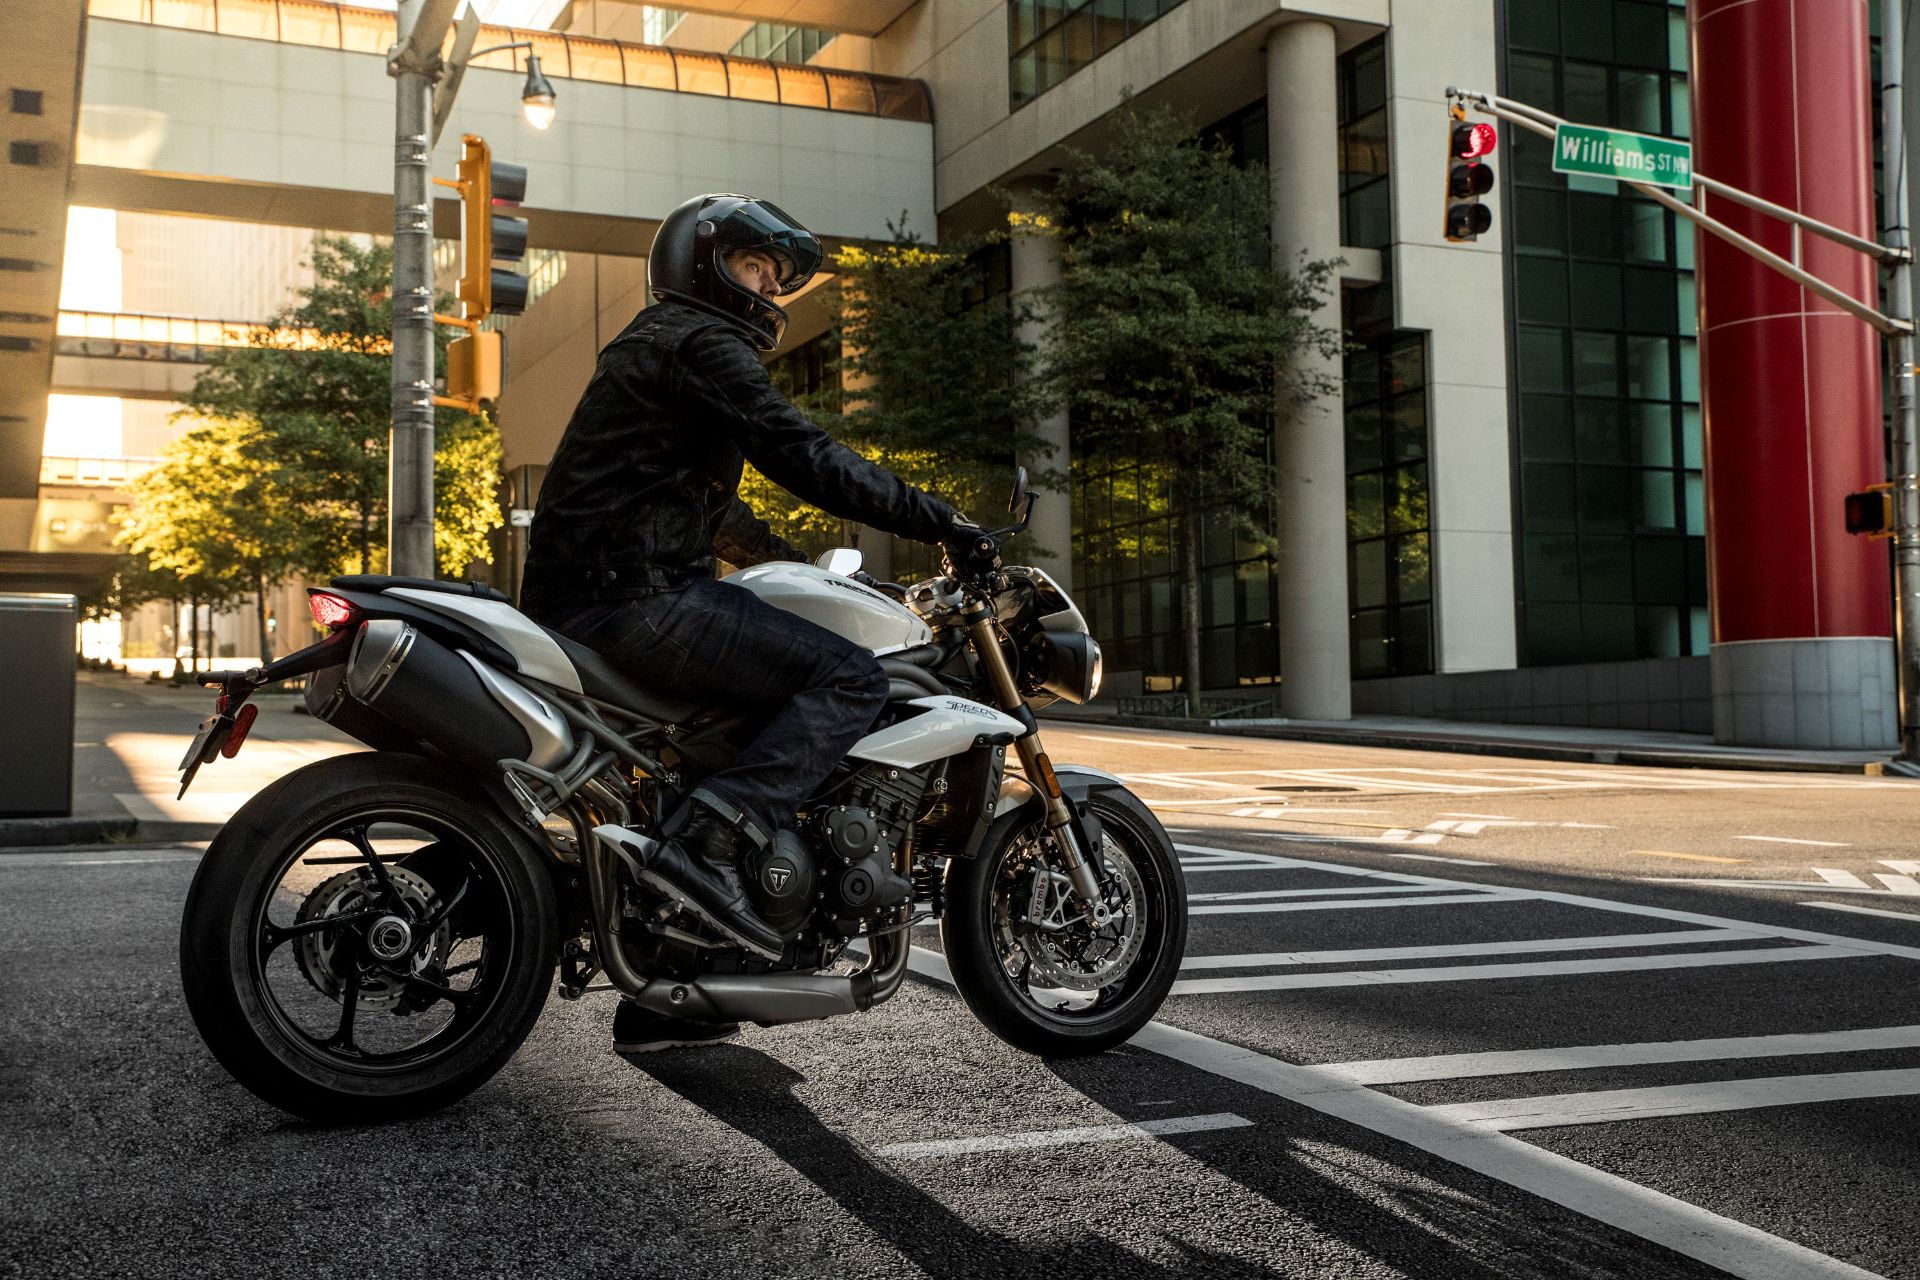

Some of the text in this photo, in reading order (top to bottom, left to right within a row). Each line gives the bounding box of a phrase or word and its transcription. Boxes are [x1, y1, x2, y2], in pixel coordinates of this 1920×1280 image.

[1561, 135, 1656, 172] Williams
[1657, 153, 1671, 172] ST
[1032, 877, 1047, 917] brembo
